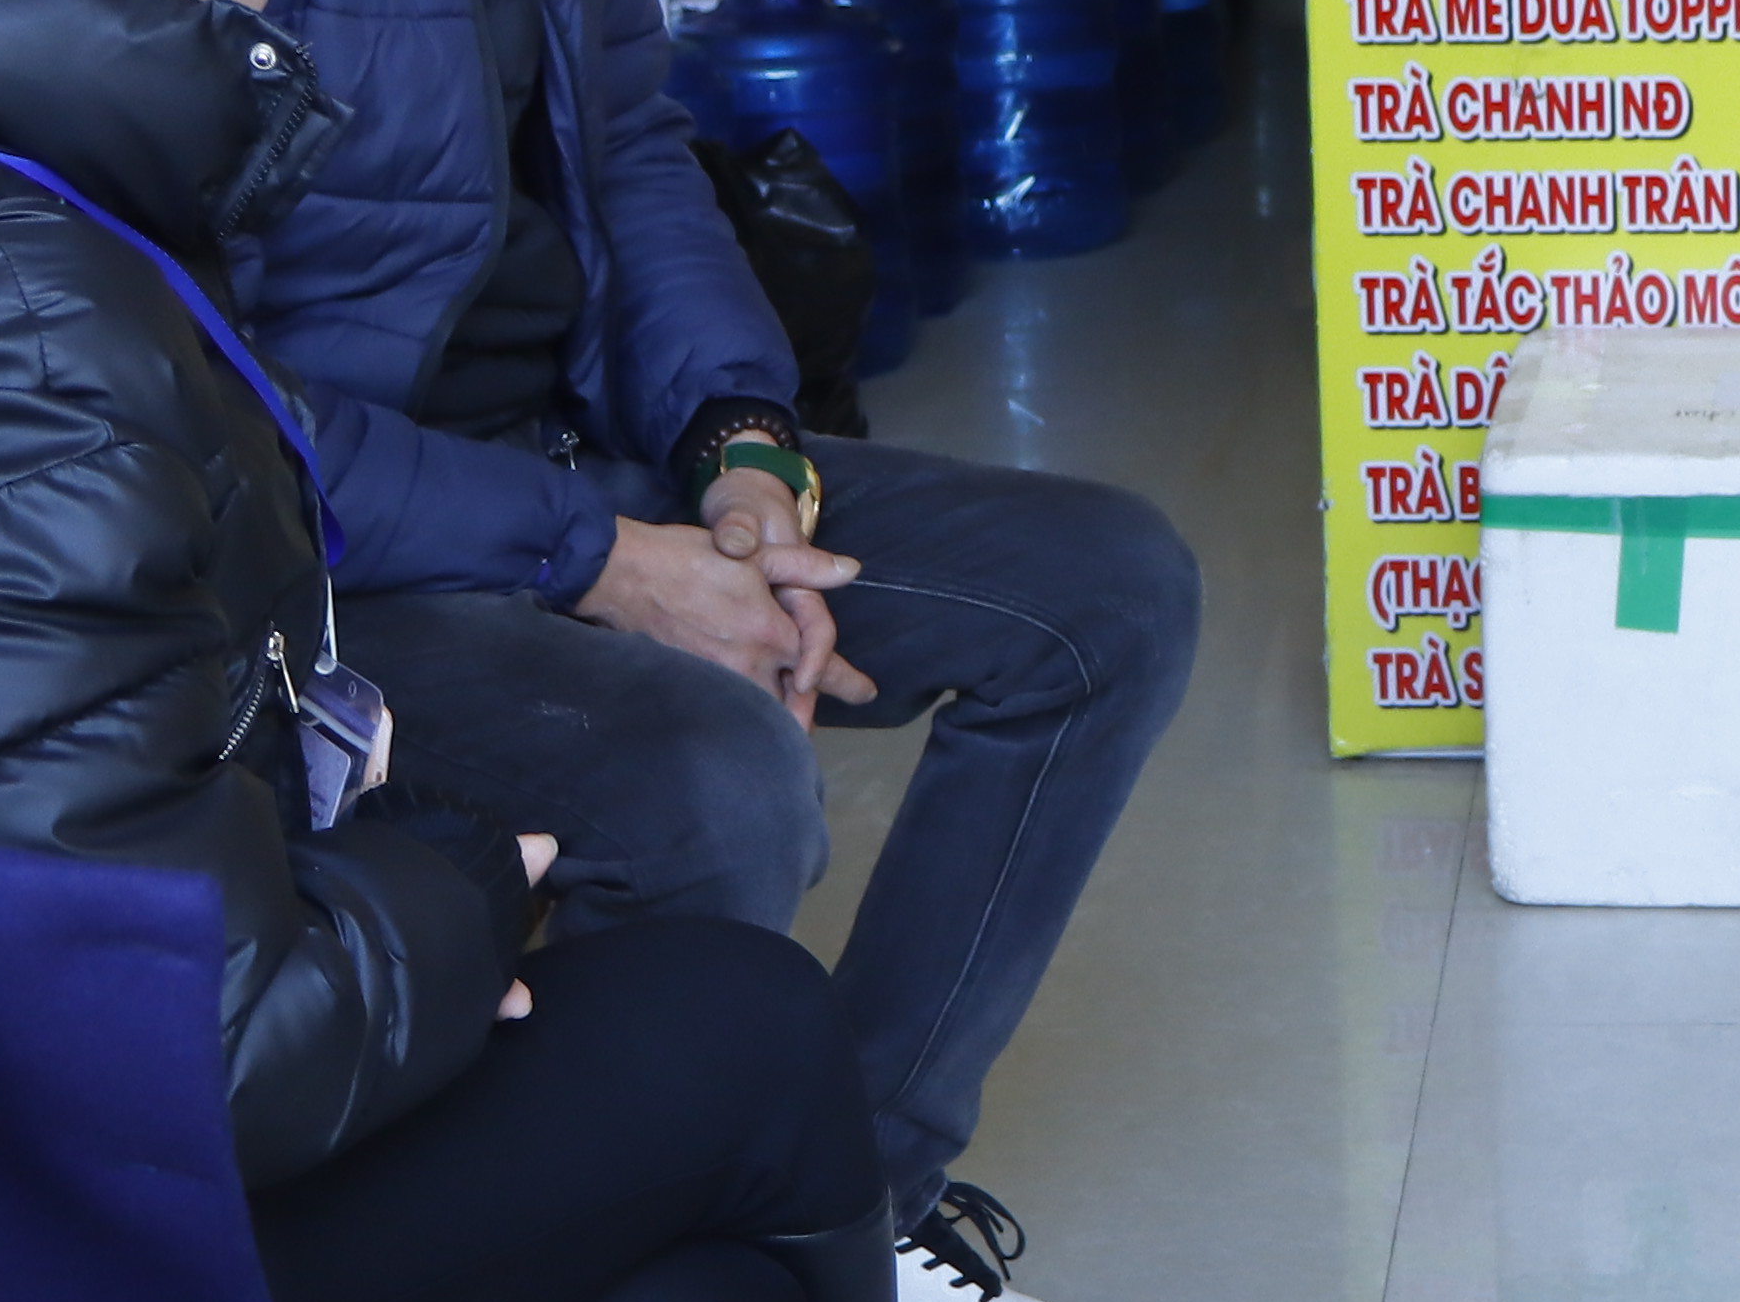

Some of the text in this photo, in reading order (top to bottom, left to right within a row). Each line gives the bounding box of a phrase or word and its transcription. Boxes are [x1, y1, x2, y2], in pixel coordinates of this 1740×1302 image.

[1352, 66, 1435, 135] TRÀ
[1445, 80, 1607, 135] CHANH
[1620, 79, 1685, 133] NĐ
[1355, 161, 1438, 228] TRÀ
[1448, 174, 1609, 229] CHANH
[1619, 158, 1733, 226] TRÂN
[1358, 261, 1441, 328] TRÀ
[1449, 249, 1538, 328] TẮC
[1548, 255, 1670, 327] THẢO
[1361, 356, 1443, 422] TRÀ
[1364, 451, 1446, 516] TRÀ
[1371, 637, 1452, 702] TRÀ
